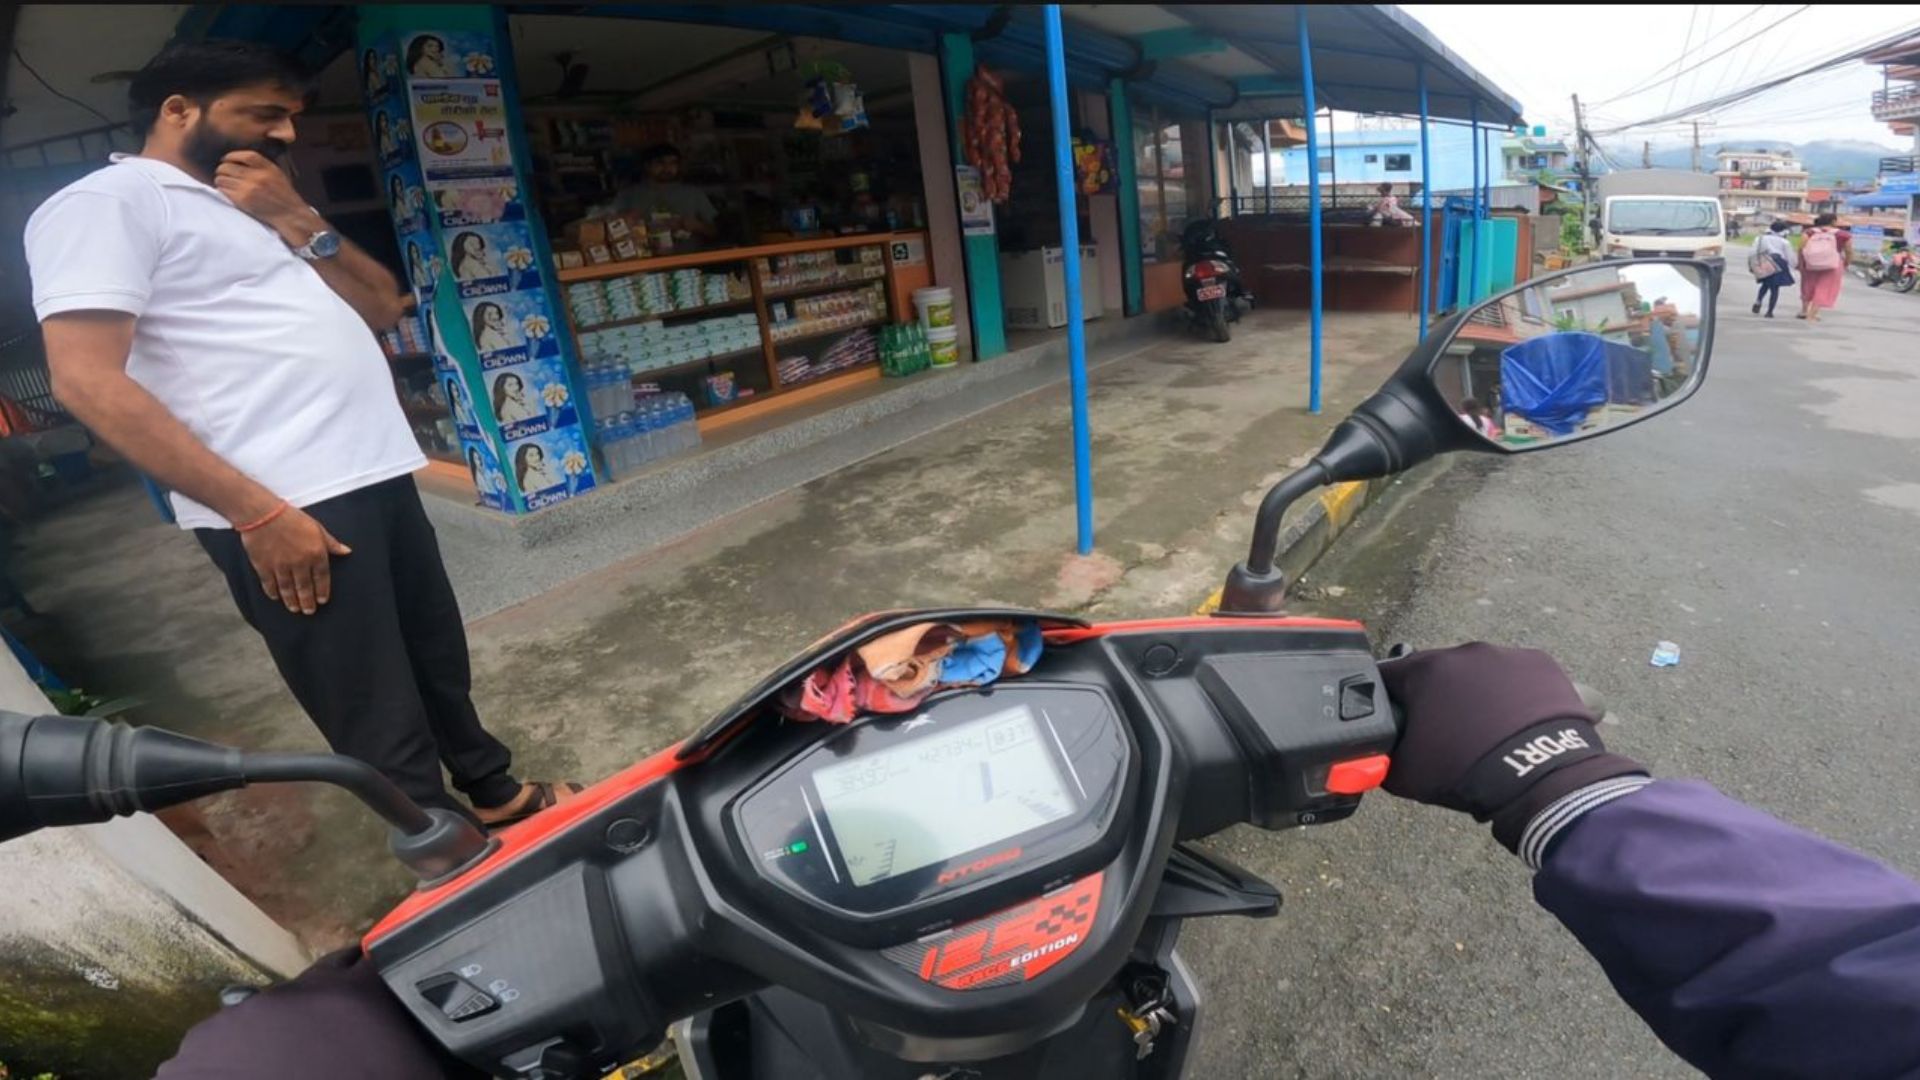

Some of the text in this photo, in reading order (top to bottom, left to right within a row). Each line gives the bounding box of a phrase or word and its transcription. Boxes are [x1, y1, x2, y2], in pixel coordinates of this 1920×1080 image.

[462, 283, 508, 297] CROWN
[483, 352, 527, 369] CROWN
[504, 422, 548, 441] CROWN
[527, 490, 568, 511] CROWN
[1502, 728, 1590, 778] SPORT
[1009, 932, 1079, 968] EDITION
